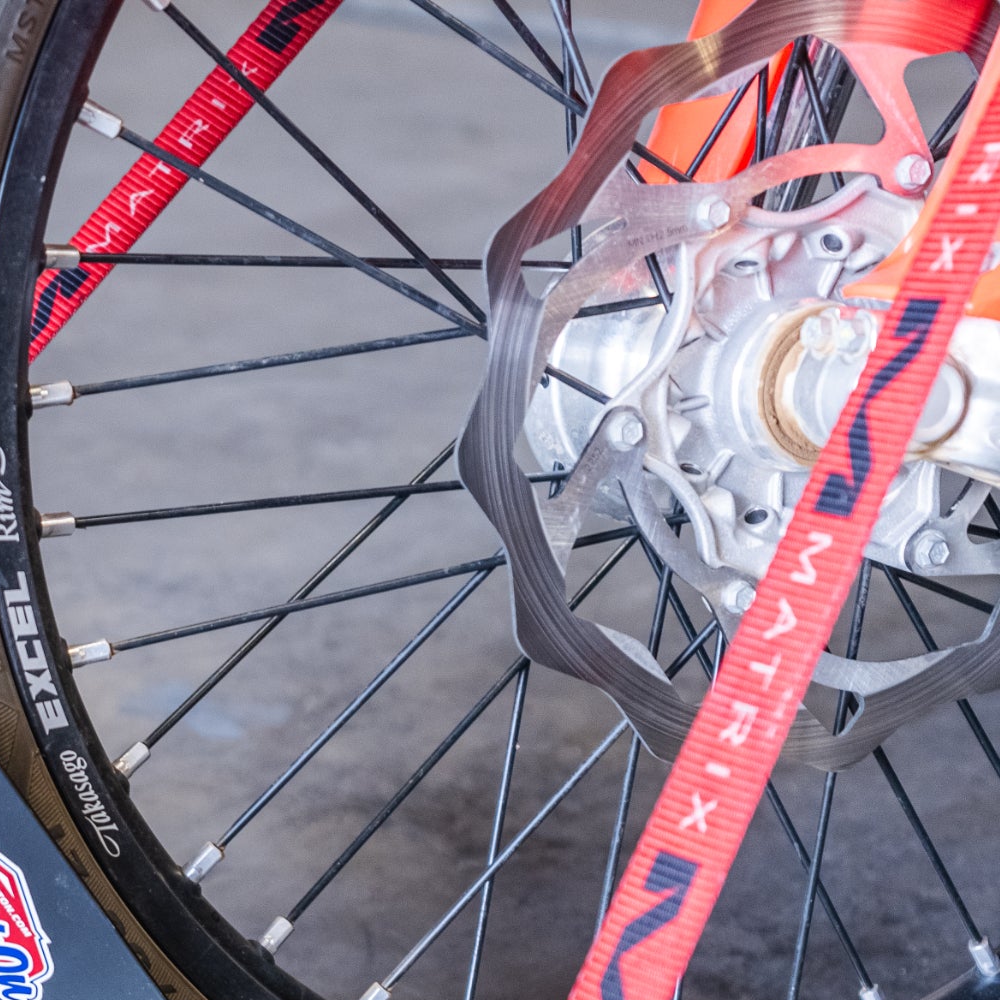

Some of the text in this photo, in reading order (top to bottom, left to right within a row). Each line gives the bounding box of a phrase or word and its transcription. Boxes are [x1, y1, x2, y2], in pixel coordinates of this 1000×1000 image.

[86, 62, 259, 253] MATRIX
[929, 140, 1000, 272] RIX
[3, 570, 70, 735] EXCEL
[678, 531, 833, 833] MATRIX
[60, 749, 121, 858] Takasago
